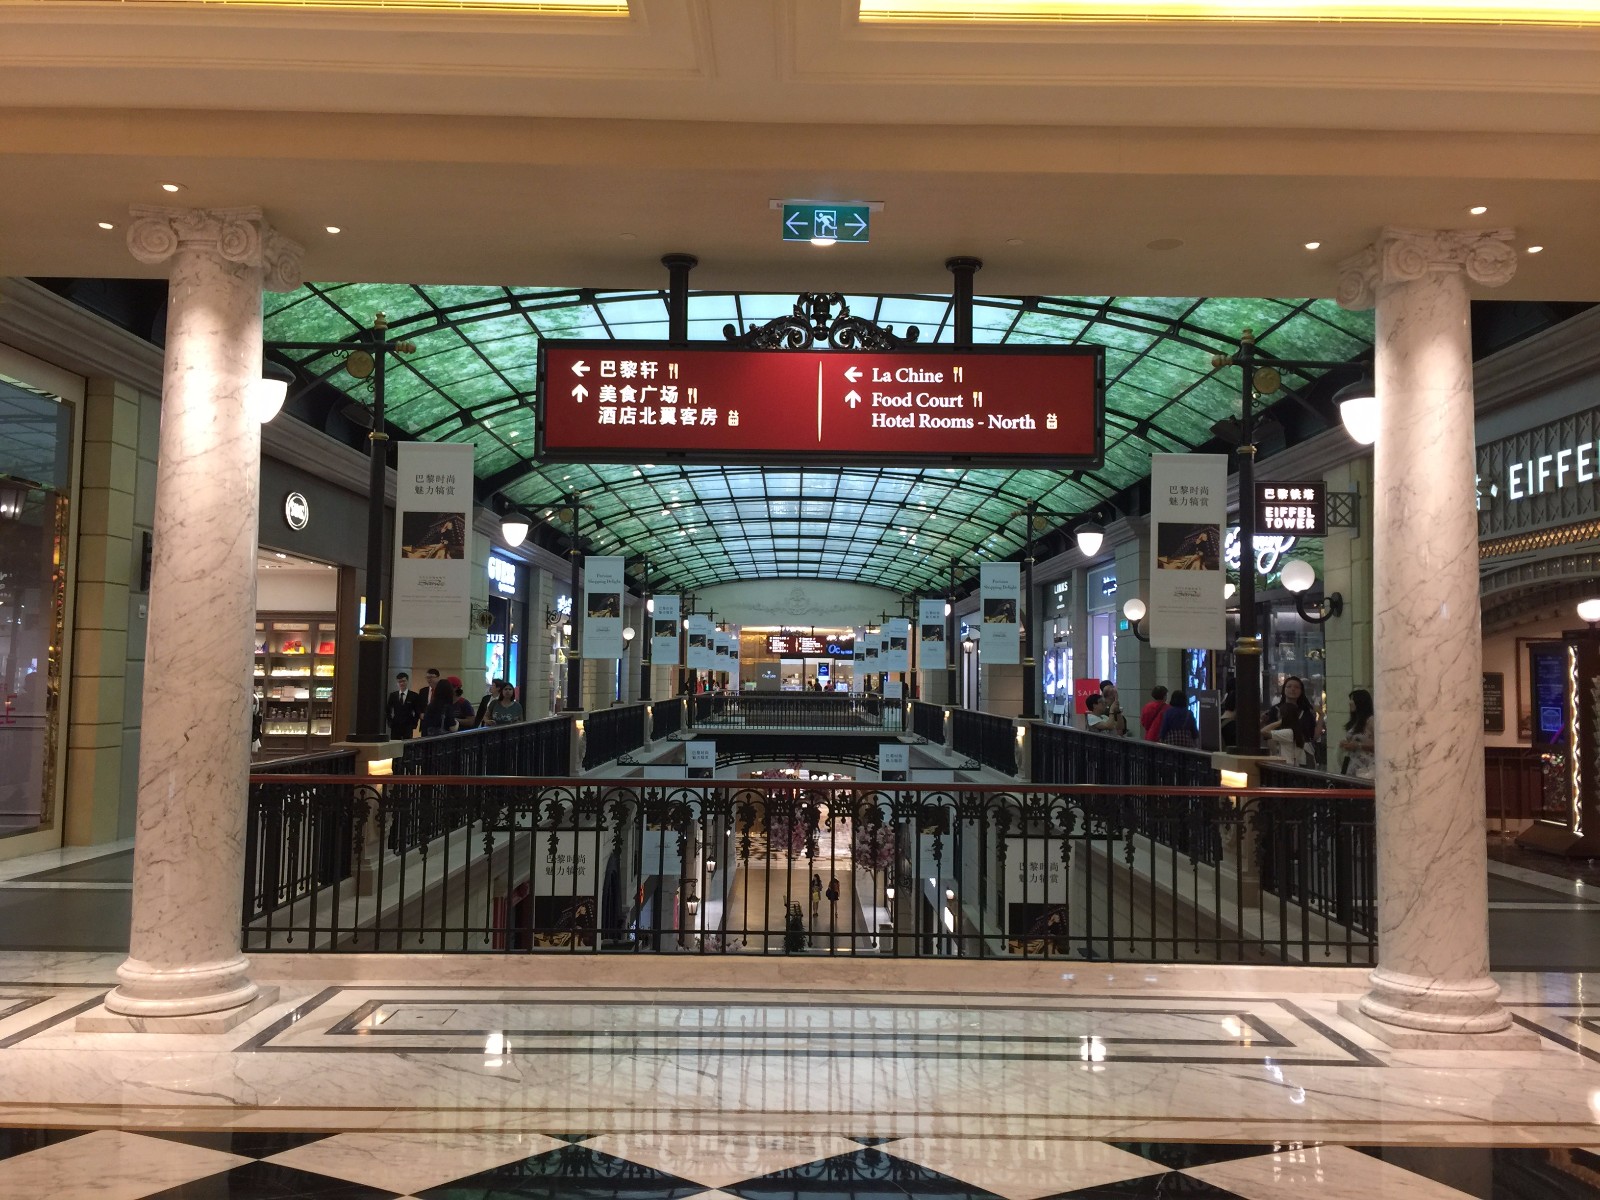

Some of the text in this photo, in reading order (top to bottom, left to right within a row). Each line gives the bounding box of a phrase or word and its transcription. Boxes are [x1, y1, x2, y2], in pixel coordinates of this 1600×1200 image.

[600, 360, 659, 380] 巴黎轩
[871, 367, 944, 383] La Chine
[599, 385, 679, 404] 美食广场
[871, 392, 964, 408] Food Court
[598, 405, 718, 426] 酒店北翼客房
[871, 412, 915, 428] Hotel
[918, 413, 975, 429] Rooms
[987, 414, 1037, 430] North
[1509, 439, 1600, 500] EIFFE
[415, 474, 456, 484] 巴黎时尚
[1169, 485, 1209, 496] 巴黎时尚
[1264, 506, 1316, 518] EIFFEL
[1264, 518, 1316, 530] TOWER
